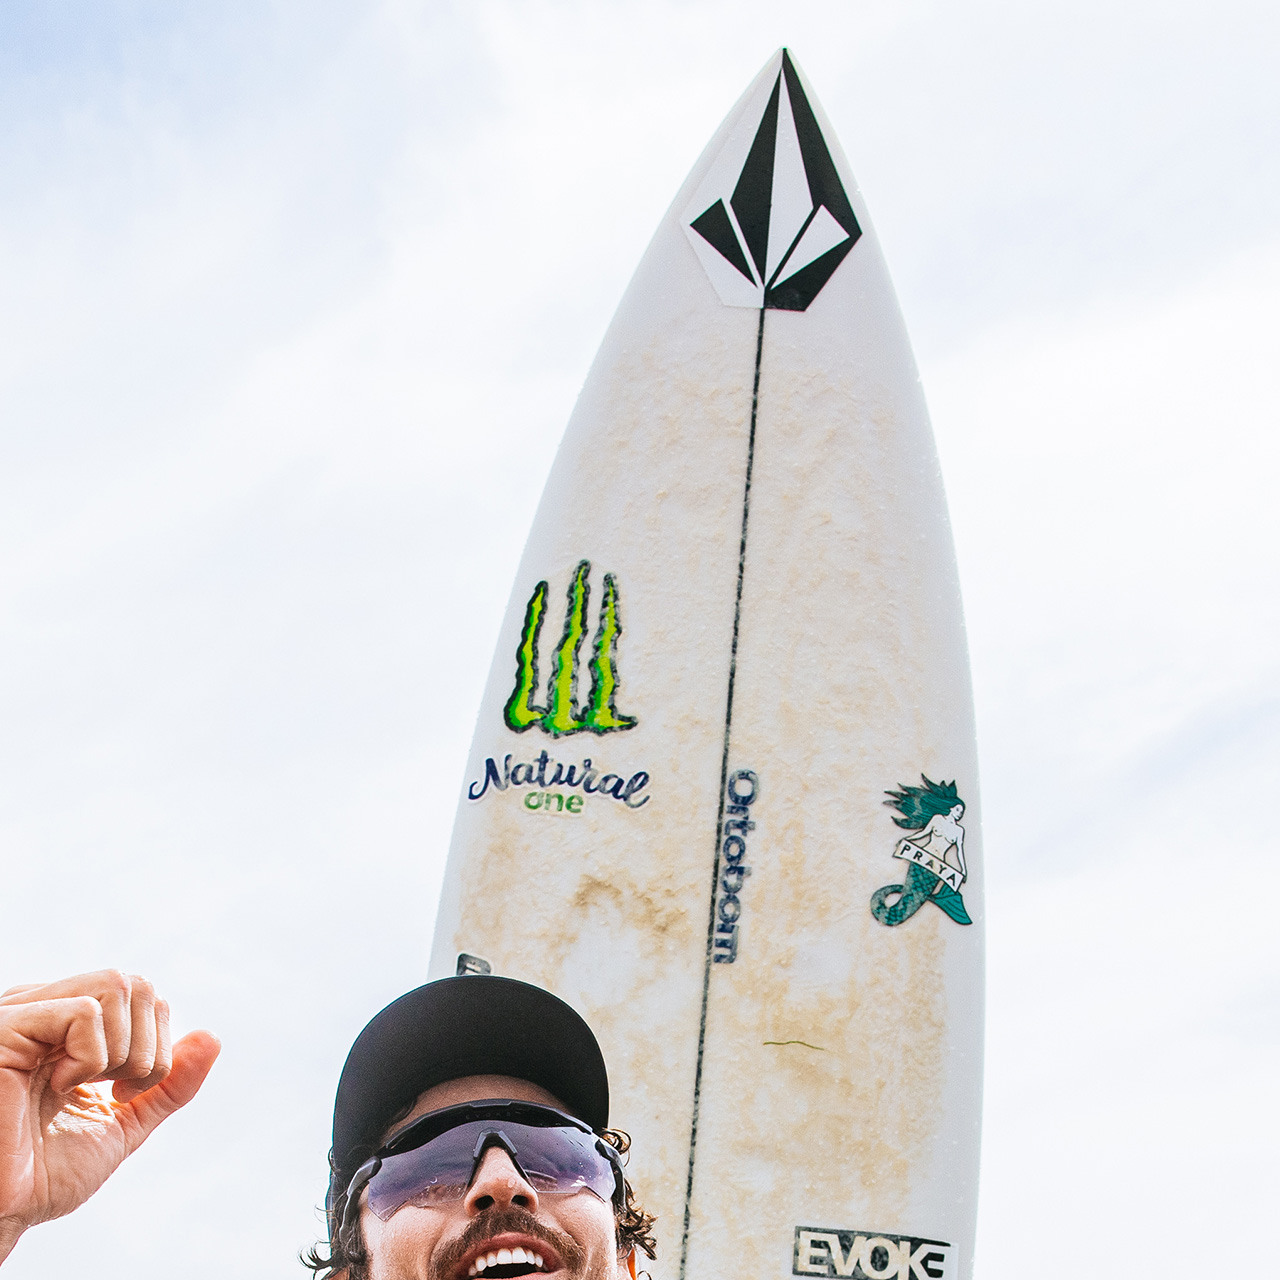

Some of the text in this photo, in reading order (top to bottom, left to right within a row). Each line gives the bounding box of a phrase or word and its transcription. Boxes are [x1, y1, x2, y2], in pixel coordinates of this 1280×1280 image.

[468, 750, 650, 809] Natural
[524, 792, 584, 813] one
[714, 769, 760, 964] Ortobom
[900, 843, 957, 887] PRAYA
